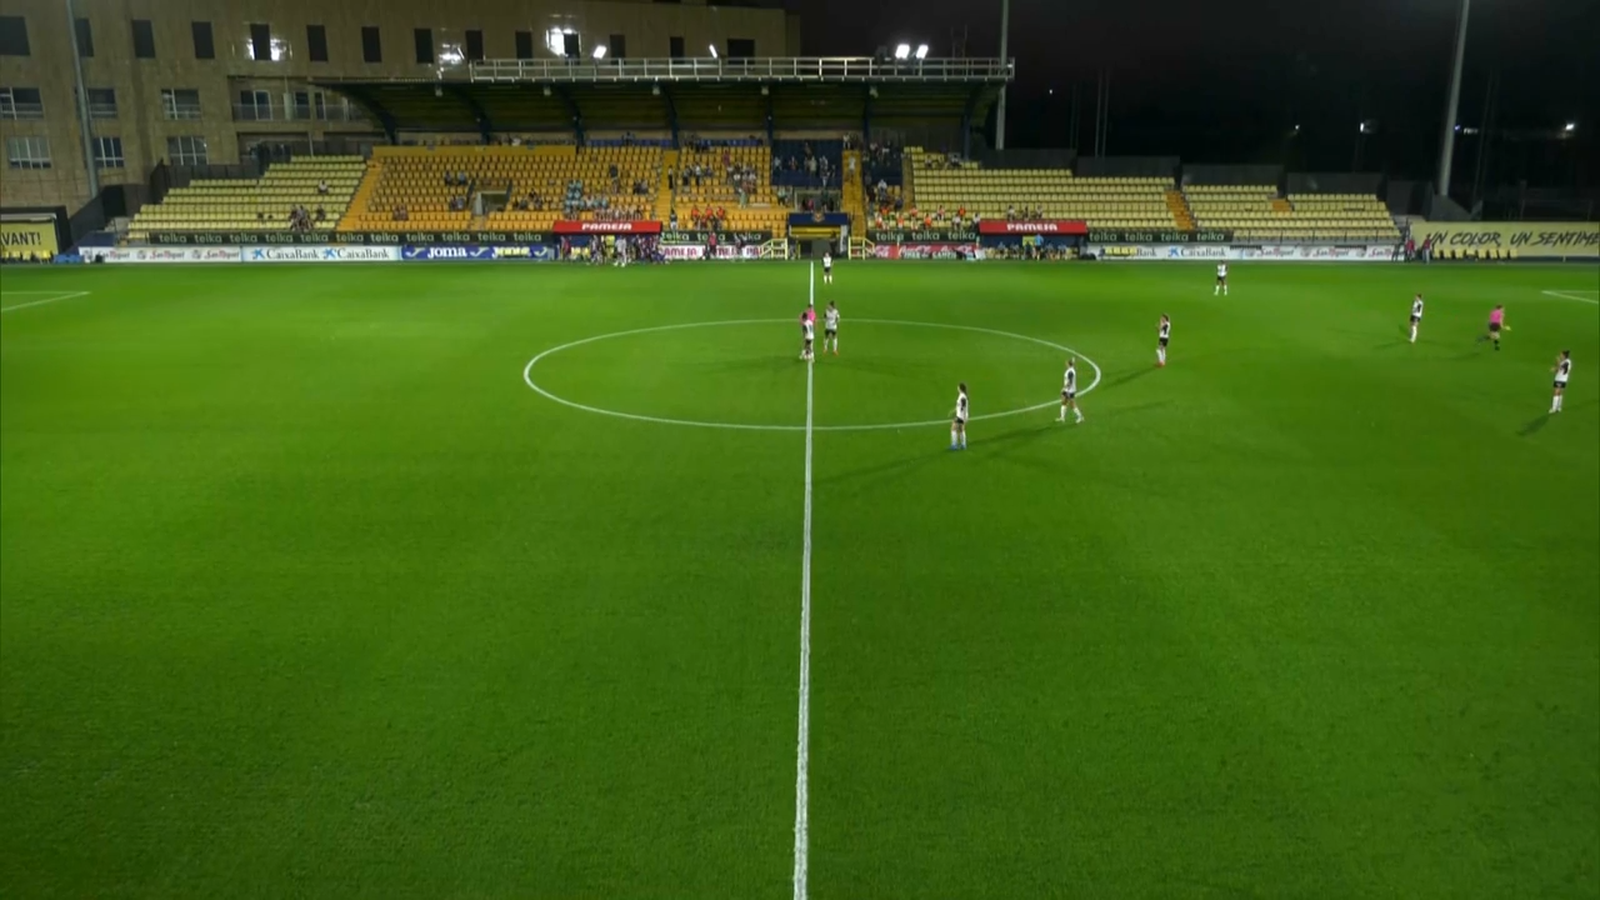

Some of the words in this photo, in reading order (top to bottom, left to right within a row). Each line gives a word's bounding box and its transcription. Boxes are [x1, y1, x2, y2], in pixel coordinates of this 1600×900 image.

[266, 247, 319, 259] CaixaBank
[337, 247, 389, 259] CaixaBank
[1181, 246, 1226, 257] CaixaBank
